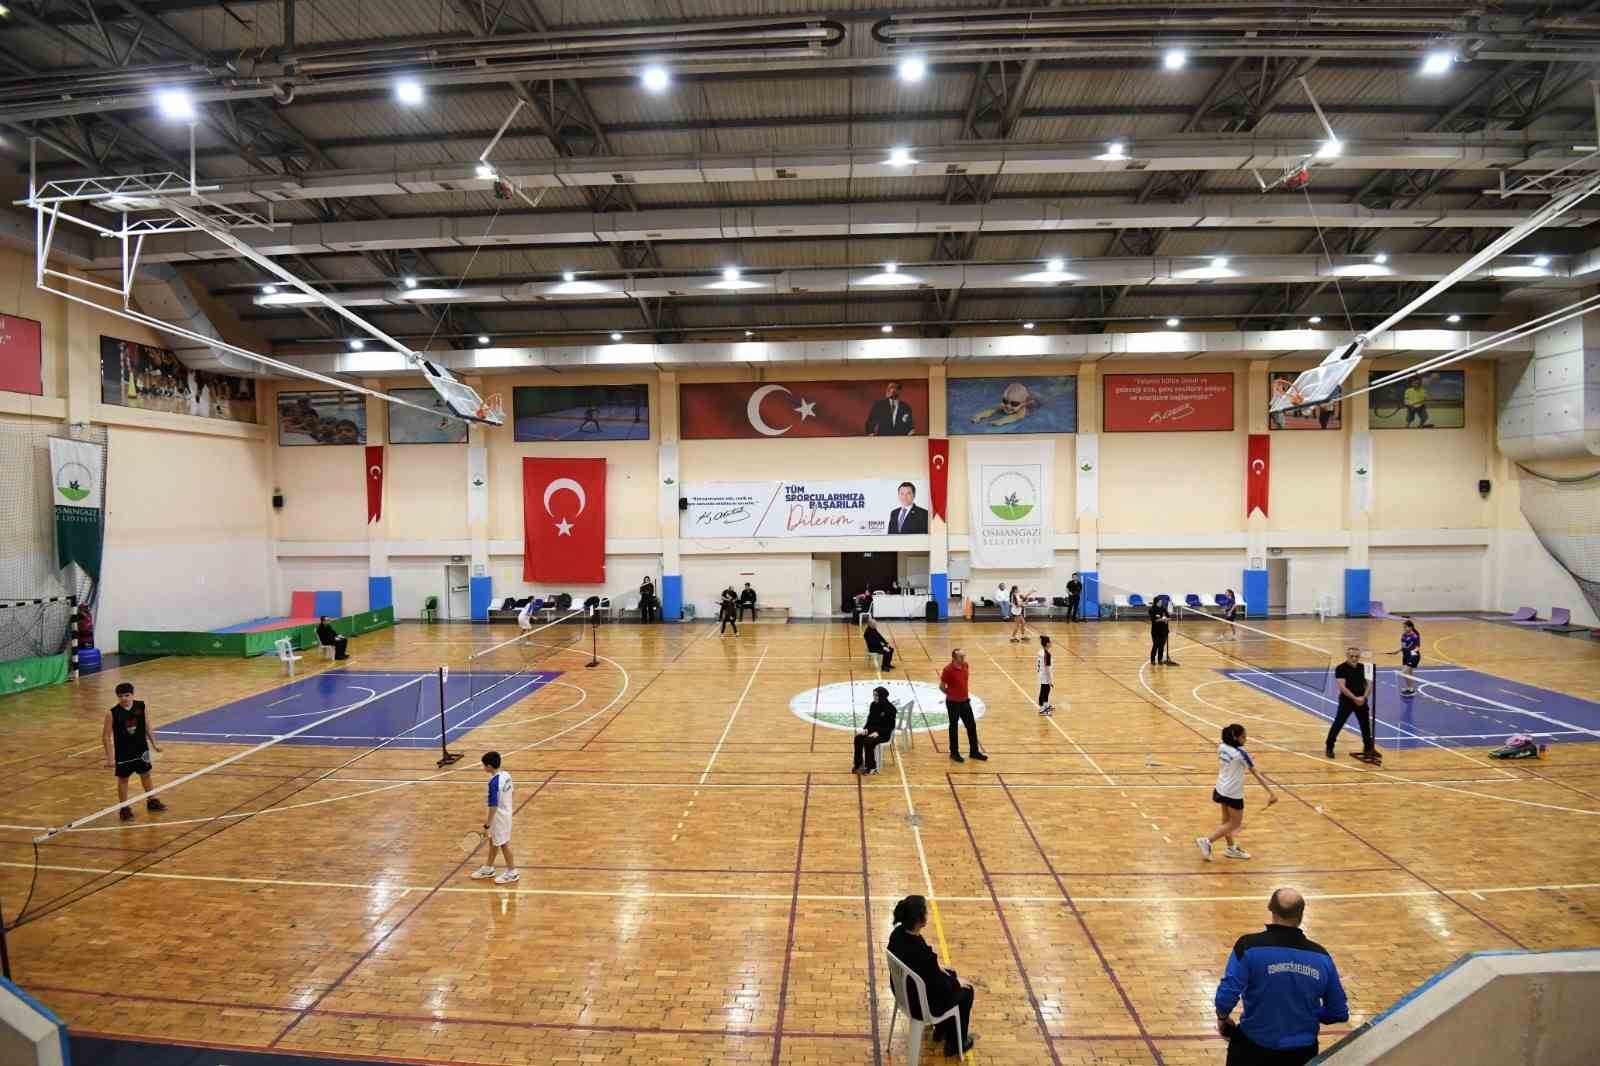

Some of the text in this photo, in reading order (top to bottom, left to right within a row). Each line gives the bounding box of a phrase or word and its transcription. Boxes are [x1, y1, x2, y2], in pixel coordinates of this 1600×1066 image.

[785, 485, 805, 494] TÜM
[785, 493, 865, 502] SPORCULARIMIZA
[809, 501, 865, 511] BAŞARILAR
[787, 503, 855, 531] Dilerim
